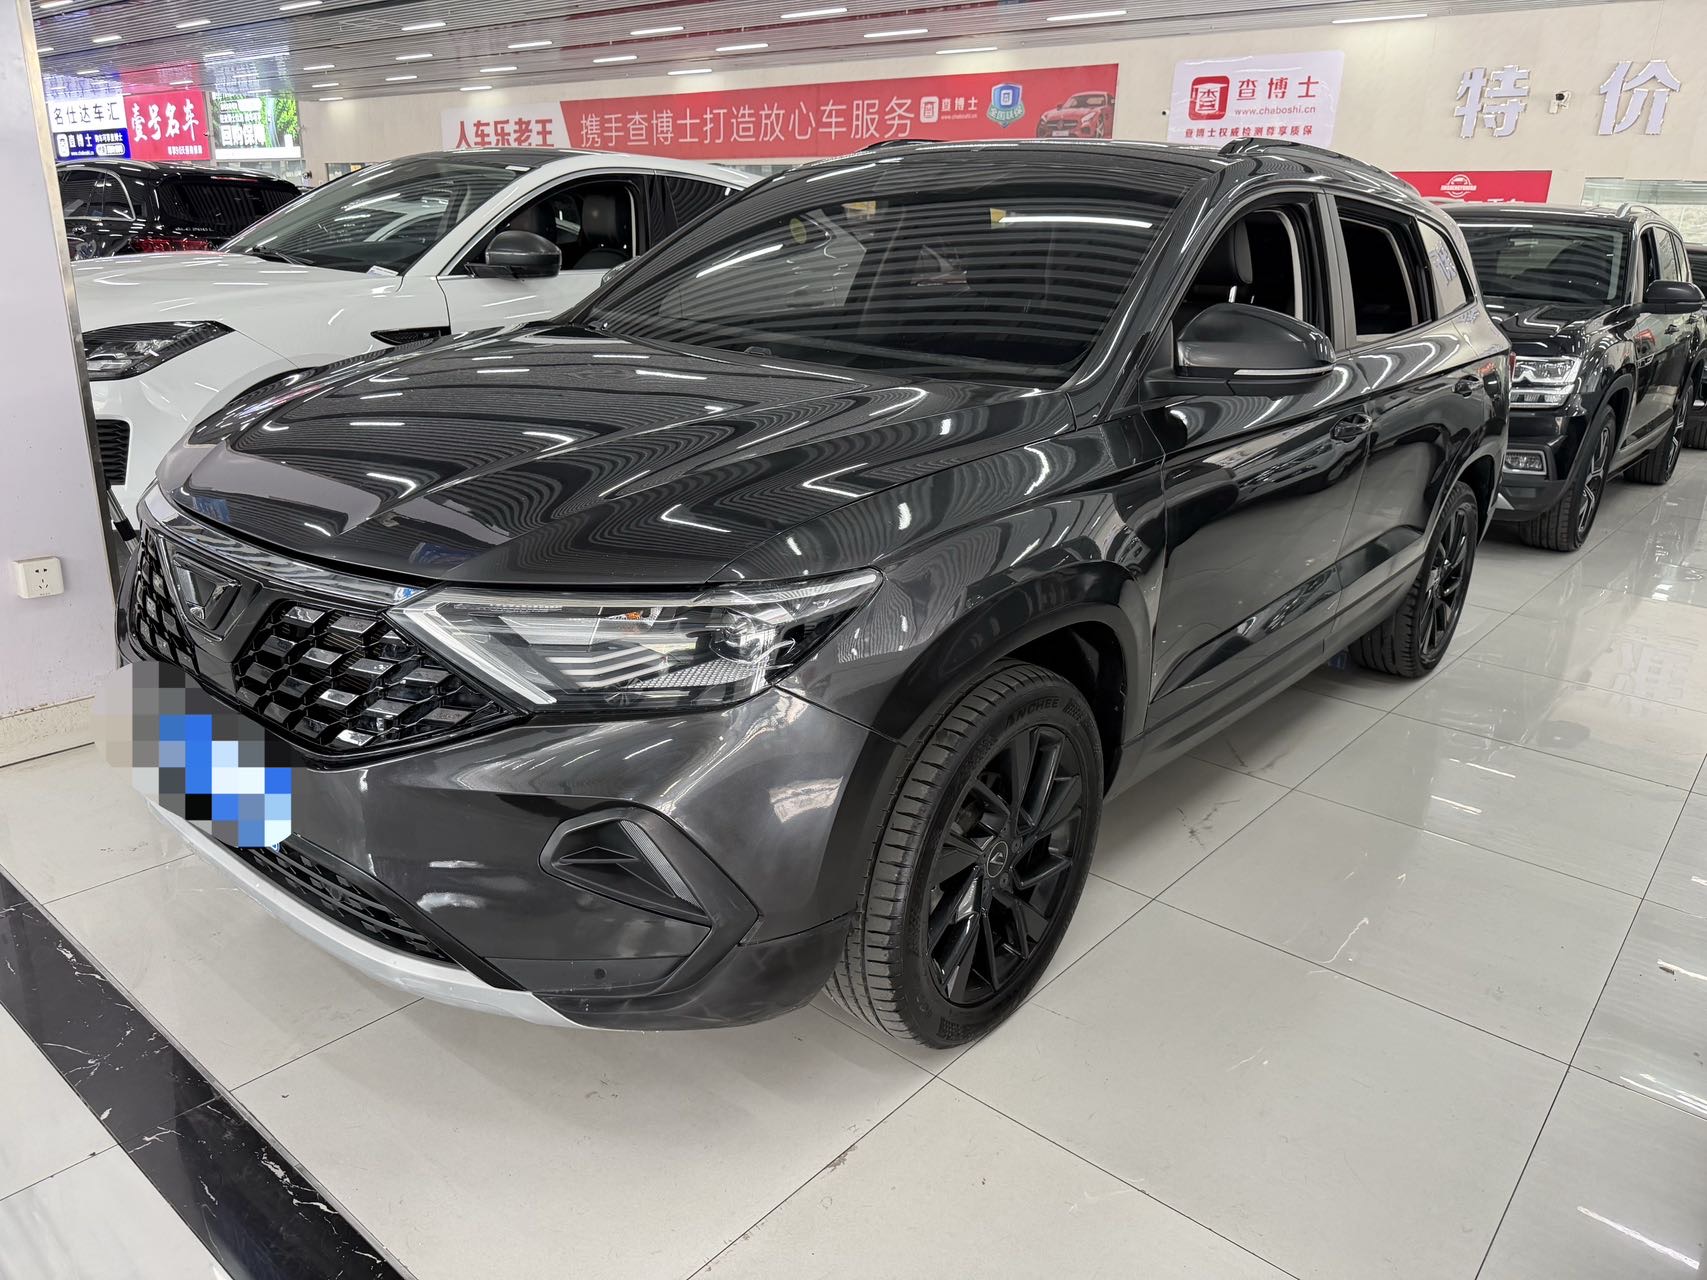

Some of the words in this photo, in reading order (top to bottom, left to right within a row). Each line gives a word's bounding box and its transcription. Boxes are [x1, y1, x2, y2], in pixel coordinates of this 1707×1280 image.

[1236, 75, 1319, 101] 查博士
[1454, 58, 1682, 138] 特价
[53, 102, 120, 125] 名仕达车汇
[941, 96, 978, 112] 查博士
[1234, 104, 1316, 116] www.chaboshi.cn
[455, 117, 555, 149] 人车乐老王
[580, 95, 915, 148] 携手查博士打造放心车服务
